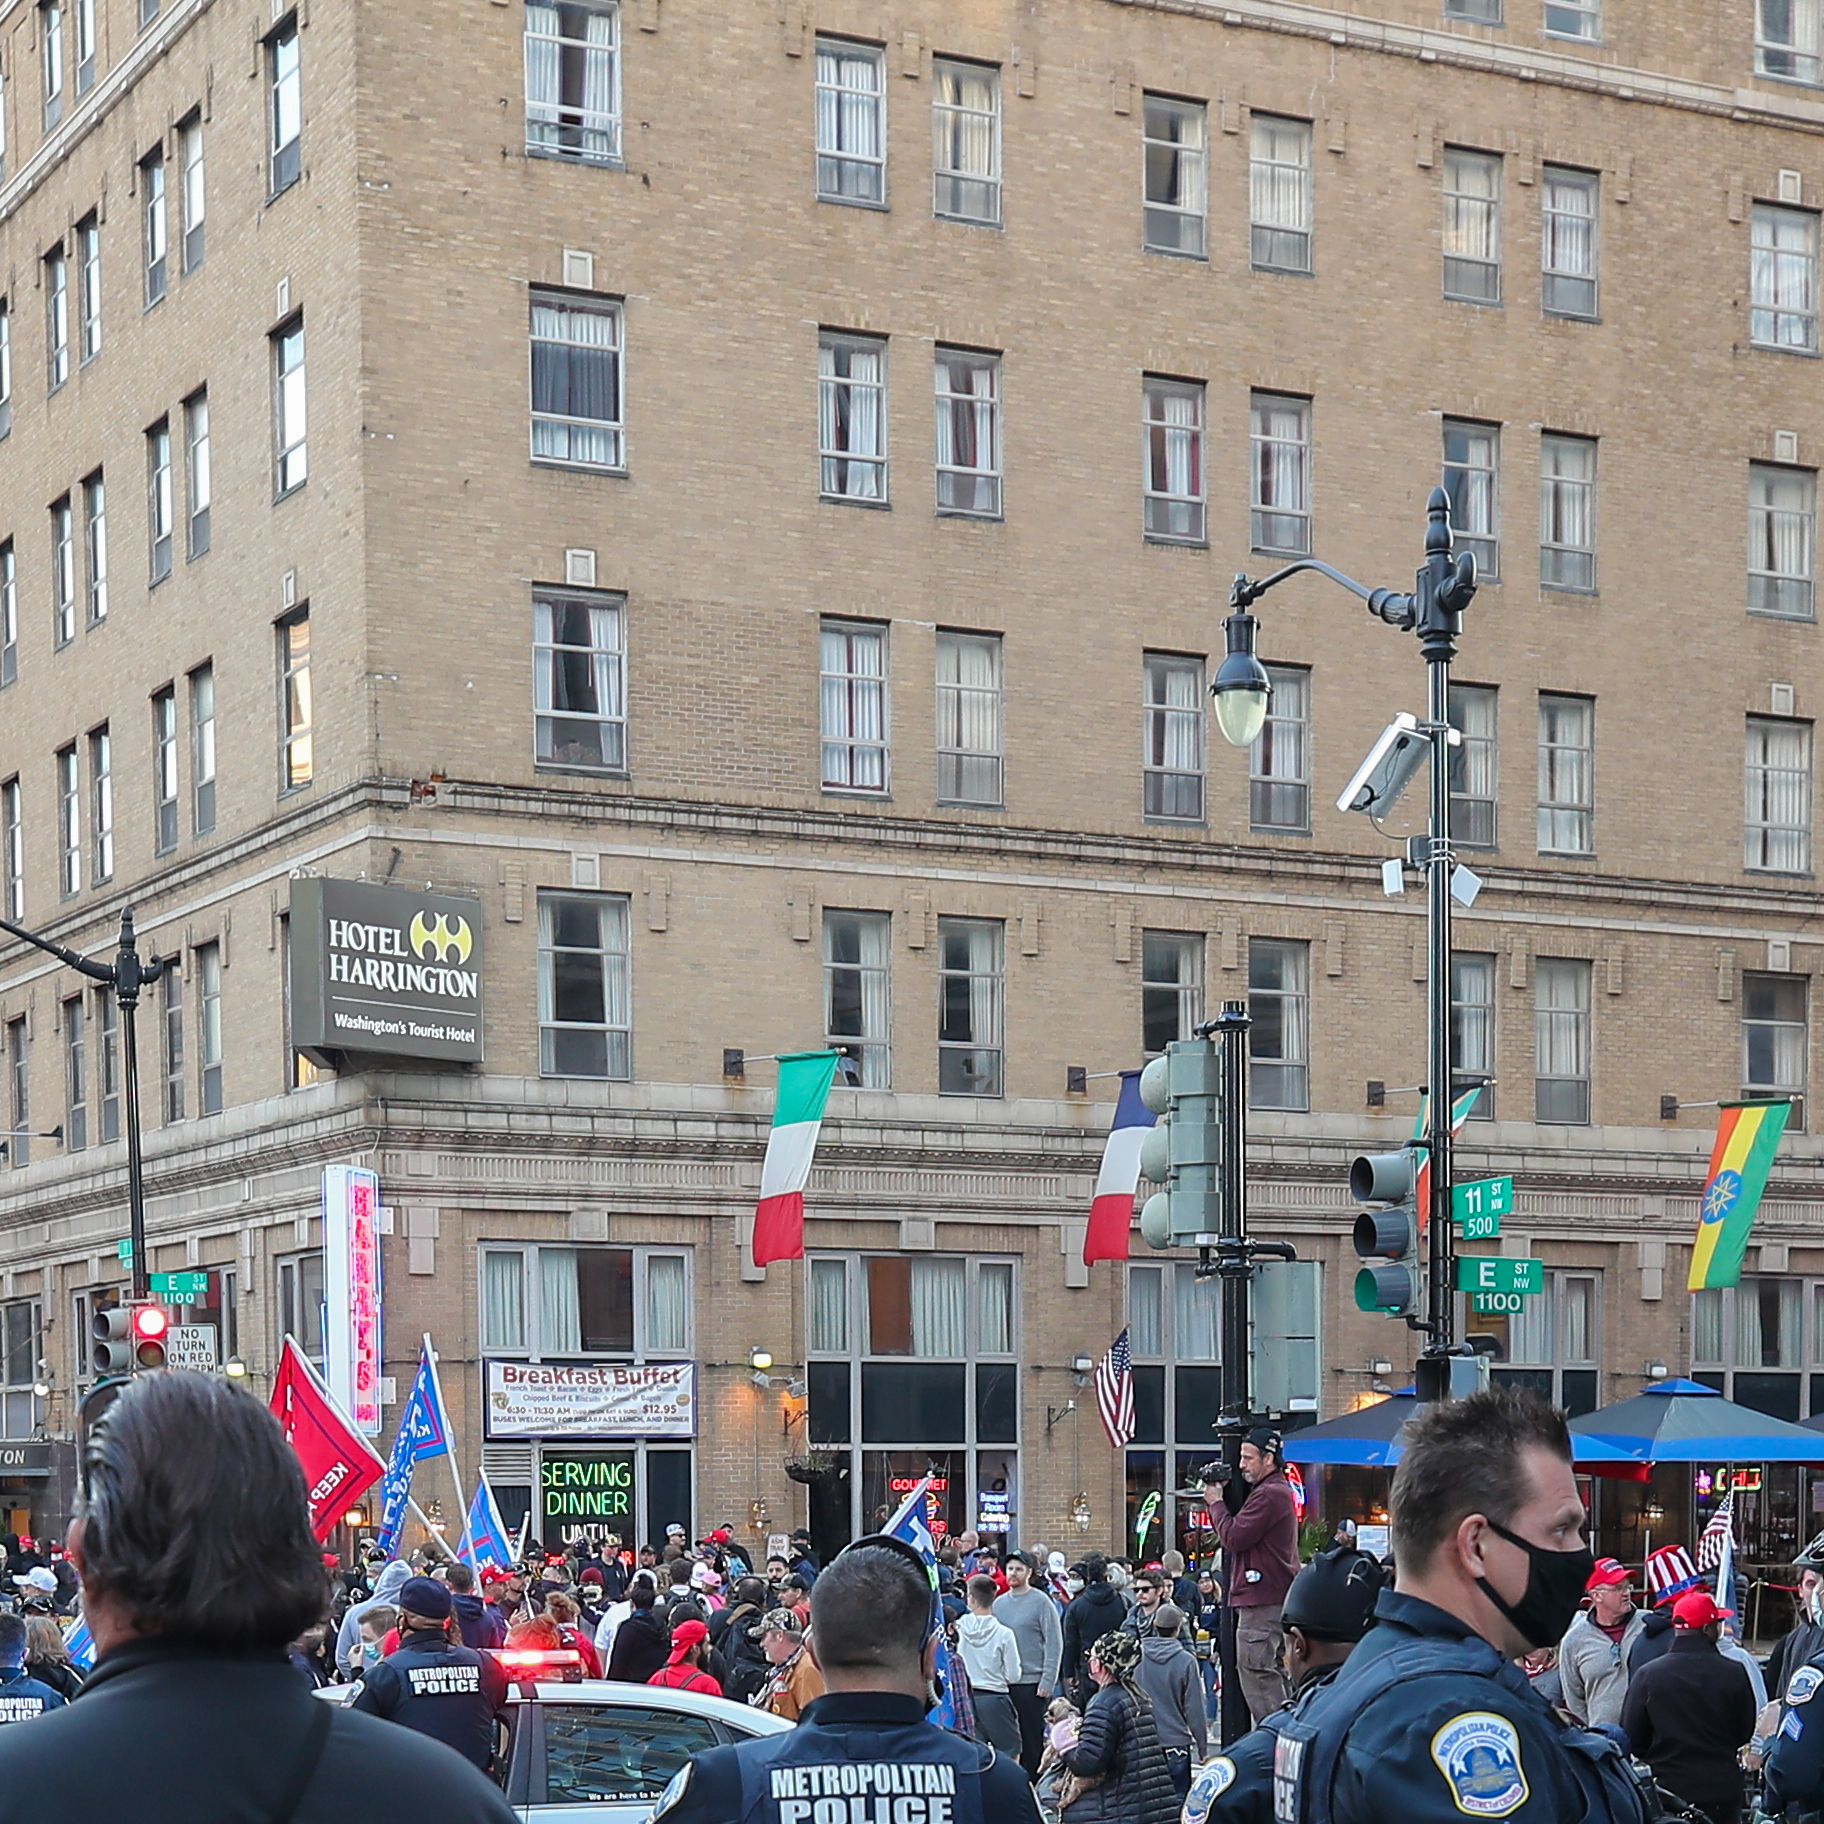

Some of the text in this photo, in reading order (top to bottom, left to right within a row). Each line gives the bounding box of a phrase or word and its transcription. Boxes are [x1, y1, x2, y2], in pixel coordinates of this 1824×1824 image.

[329, 919, 409, 957] HOTEL
[329, 953, 478, 998] HARRINGTON
[334, 1013, 475, 1043] Washington's Tourist Hotel
[1491, 1183, 1502, 1195] ST
[1465, 1187, 1482, 1213] 11
[1491, 1198, 1504, 1210] NW
[1468, 1217, 1493, 1236] 500
[1480, 1262, 1496, 1287] E
[1515, 1263, 1529, 1274] ST
[1513, 1278, 1530, 1289] NW
[1476, 1293, 1521, 1311] 1100
[503, 1366, 680, 1385] Breakfast Buffet
[643, 1404, 677, 1414] $12.95
[541, 1462, 631, 1487] SERVING
[892, 1478, 947, 1490] GOUMET
[547, 1491, 629, 1516] DINNER
[408, 1666, 479, 1681] METROPOLITAN
[414, 1679, 479, 1695] POLICE
[771, 1763, 955, 1799] METROPOLITAN
[619, 1791, 637, 1799] here
[640, 1791, 648, 1799] to
